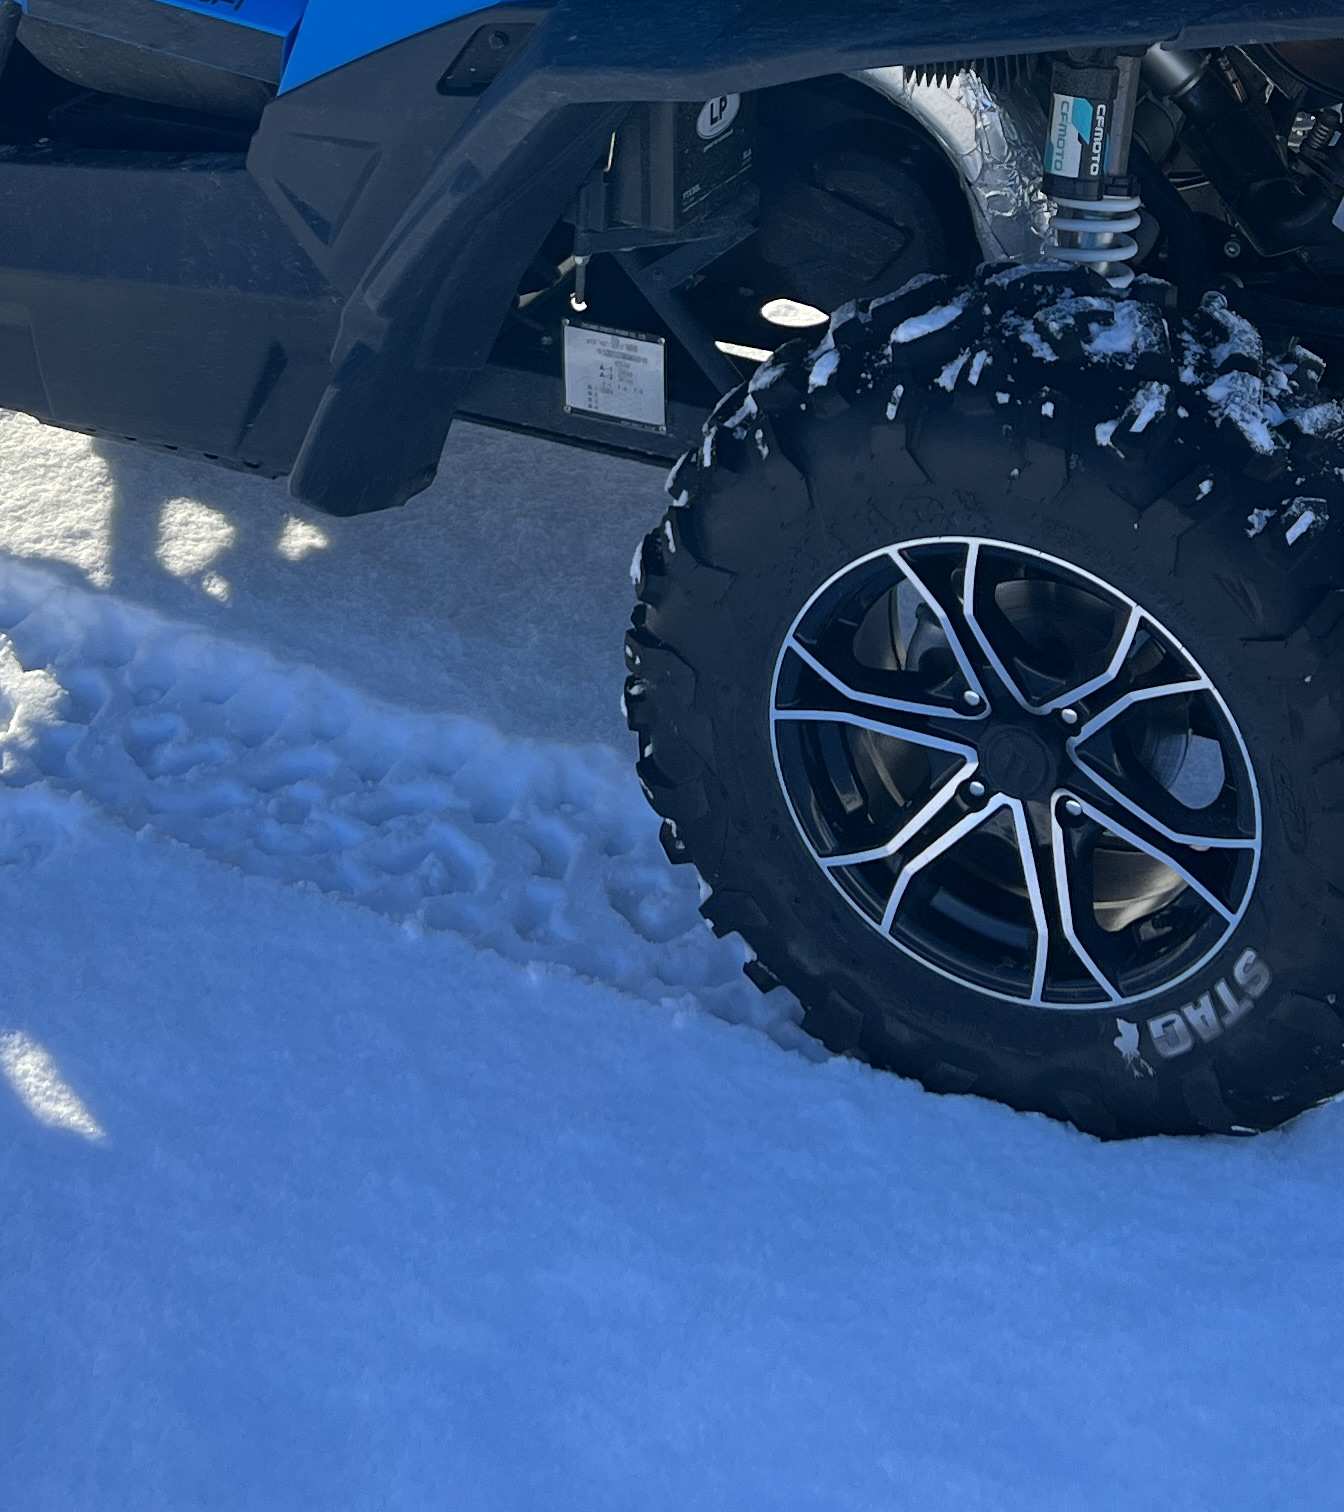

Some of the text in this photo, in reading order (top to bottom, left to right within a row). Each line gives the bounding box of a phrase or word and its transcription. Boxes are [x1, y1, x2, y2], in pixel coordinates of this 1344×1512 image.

[709, 95, 728, 126] LP
[1053, 100, 1071, 171] CFMOTO
[1089, 103, 1107, 176] CFMOTO
[1147, 947, 1273, 1059] STAG
